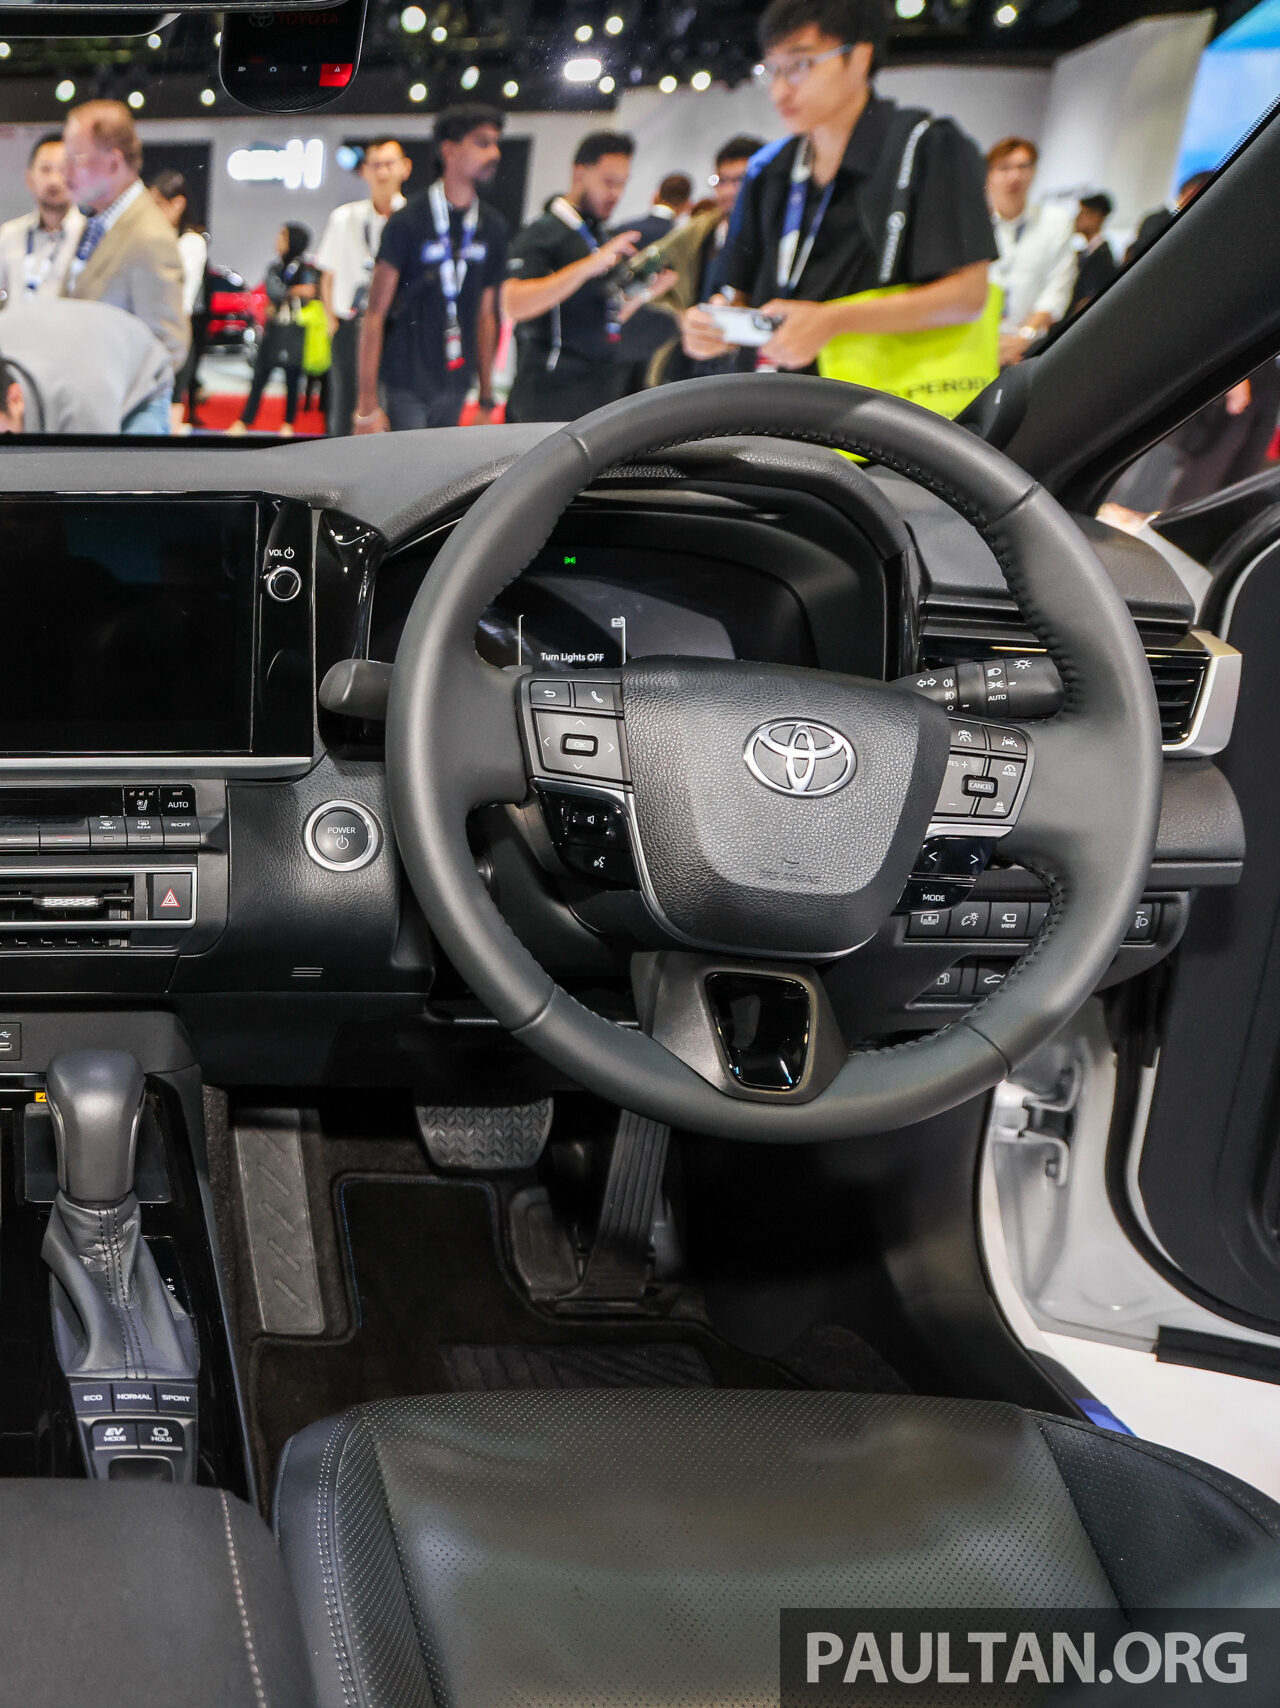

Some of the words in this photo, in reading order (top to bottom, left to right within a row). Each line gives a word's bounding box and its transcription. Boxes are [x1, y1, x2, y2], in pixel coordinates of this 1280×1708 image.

[277, 12, 340, 25] TOYOTA
[269, 549, 283, 557] VOL
[541, 652, 559, 662] Turn
[562, 652, 586, 663] Lights
[587, 653, 604, 662] OFF
[987, 693, 1007, 702] AUTO
[574, 741, 586, 749] OK
[969, 782, 992, 791] CANCEL
[168, 800, 189, 809] AUTO
[327, 826, 356, 834] POWER
[922, 893, 946, 902] MODE
[117, 1393, 152, 1401] NORMAL
[162, 1394, 190, 1402] SPORT
[105, 1427, 124, 1436] EV
[151, 1435, 173, 1443] HOLD
